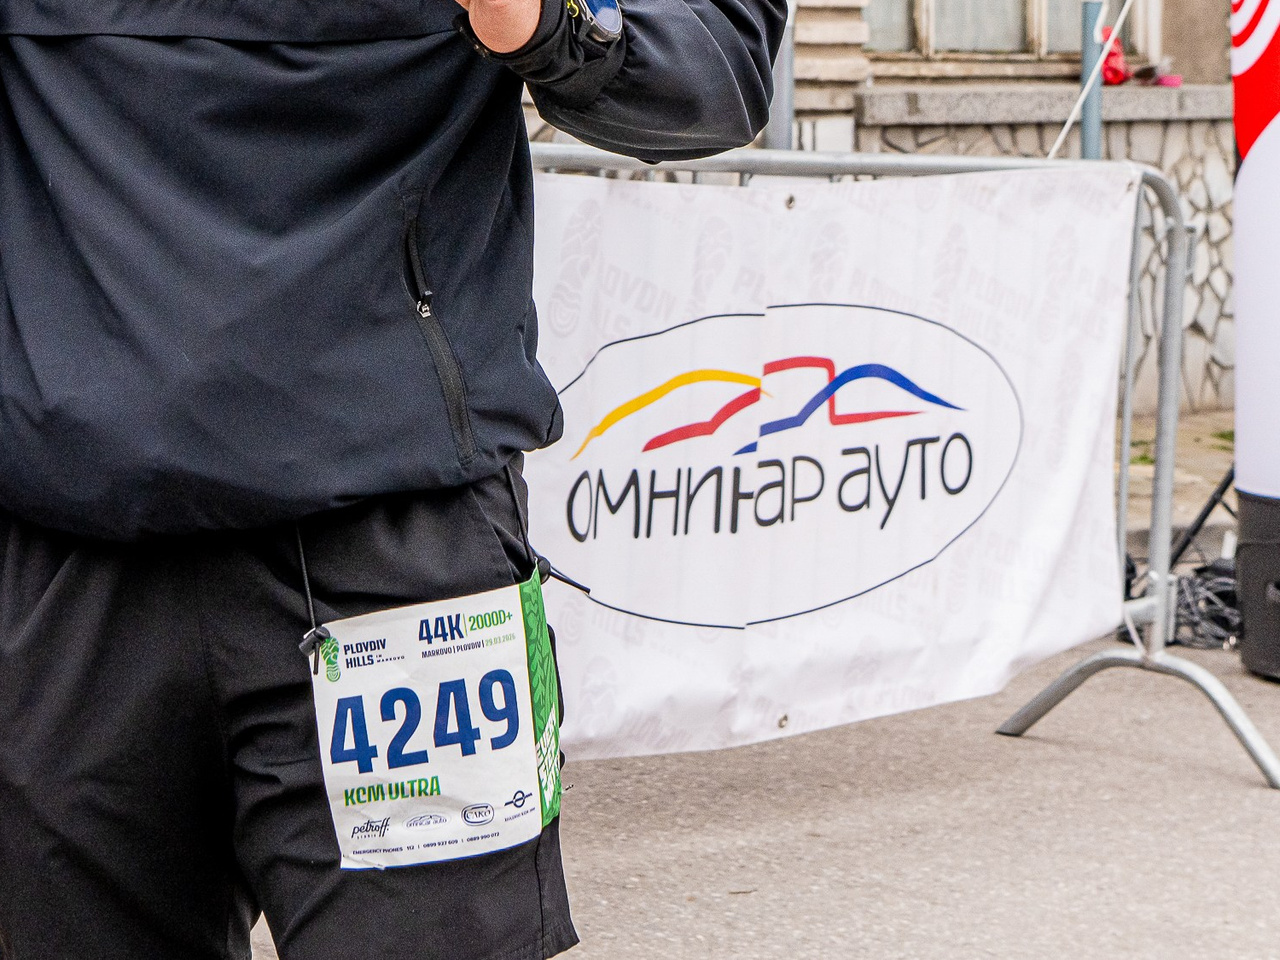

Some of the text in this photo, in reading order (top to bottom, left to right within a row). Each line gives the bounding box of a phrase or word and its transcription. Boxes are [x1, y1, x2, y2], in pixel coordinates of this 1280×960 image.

[418, 613, 465, 645] 44K
[343, 638, 386, 655] PLOVDIV
[421, 646, 452, 658] MARKOVO
[456, 641, 481, 653] PLOVDIV
[345, 654, 375, 669] HILLS
[330, 668, 520, 774] 4249
[344, 775, 441, 806] KCM ULTRA
